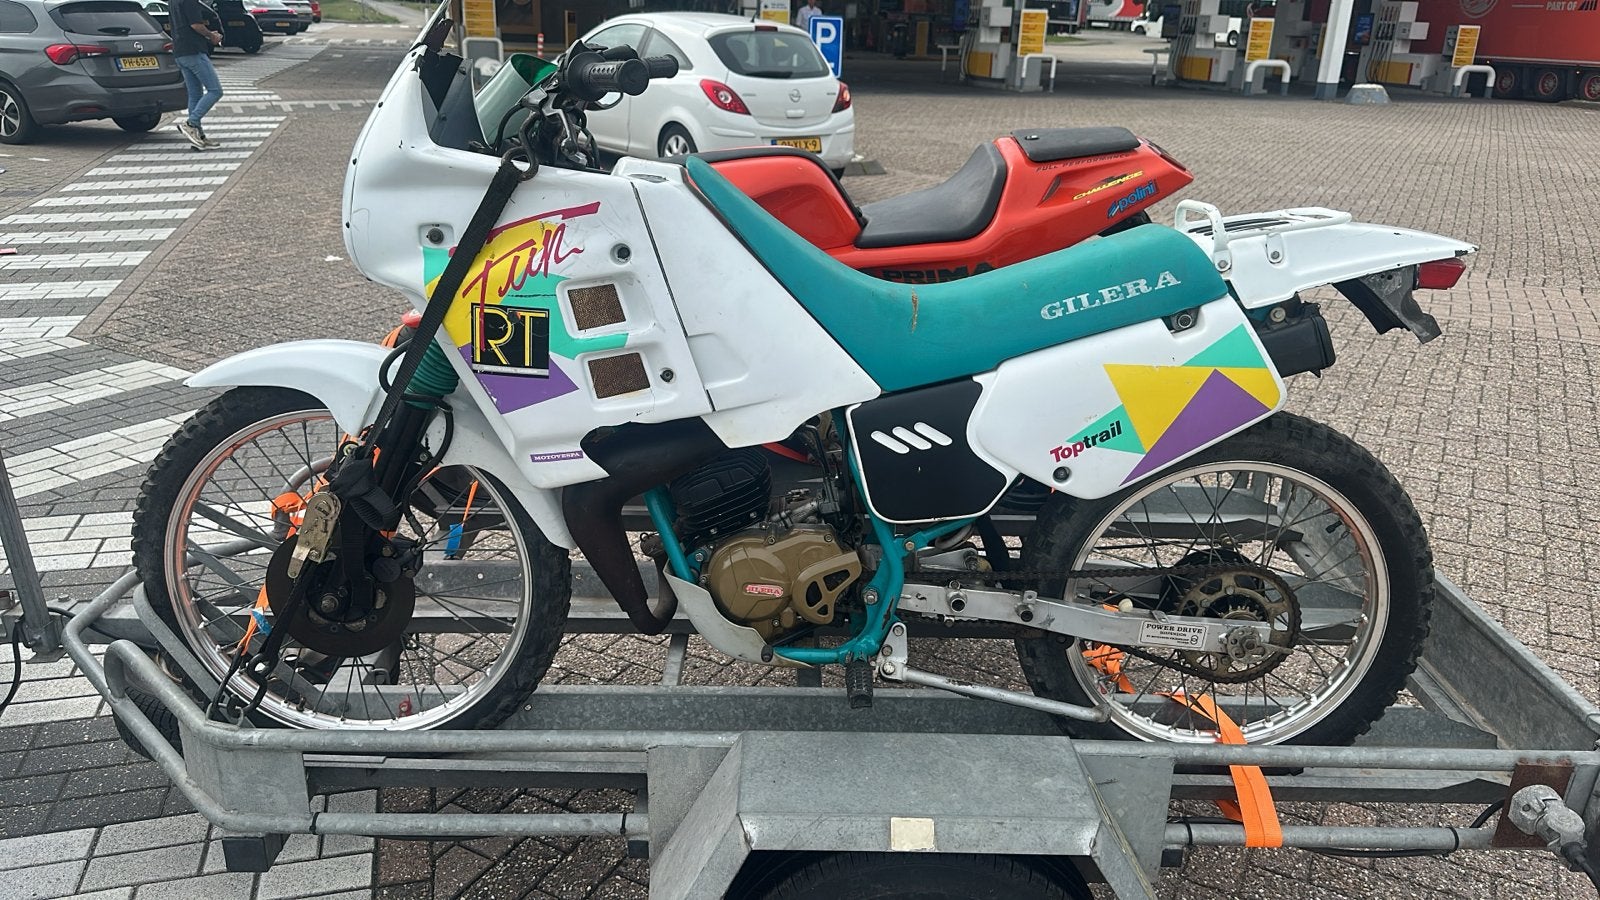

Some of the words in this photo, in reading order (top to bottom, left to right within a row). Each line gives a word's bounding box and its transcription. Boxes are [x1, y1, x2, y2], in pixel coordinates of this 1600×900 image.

[1546, 1, 1565, 10] PART
[1567, 1, 1577, 10] OF
[816, 22, 837, 54] P
[1072, 170, 1144, 200] CHALLENGE
[1040, 270, 1181, 320] GILERA
[473, 304, 548, 367] RT
[534, 452, 580, 461] MOTOVESPA
[1146, 623, 1175, 632] POWER
[1177, 626, 1203, 634] DRIVE
